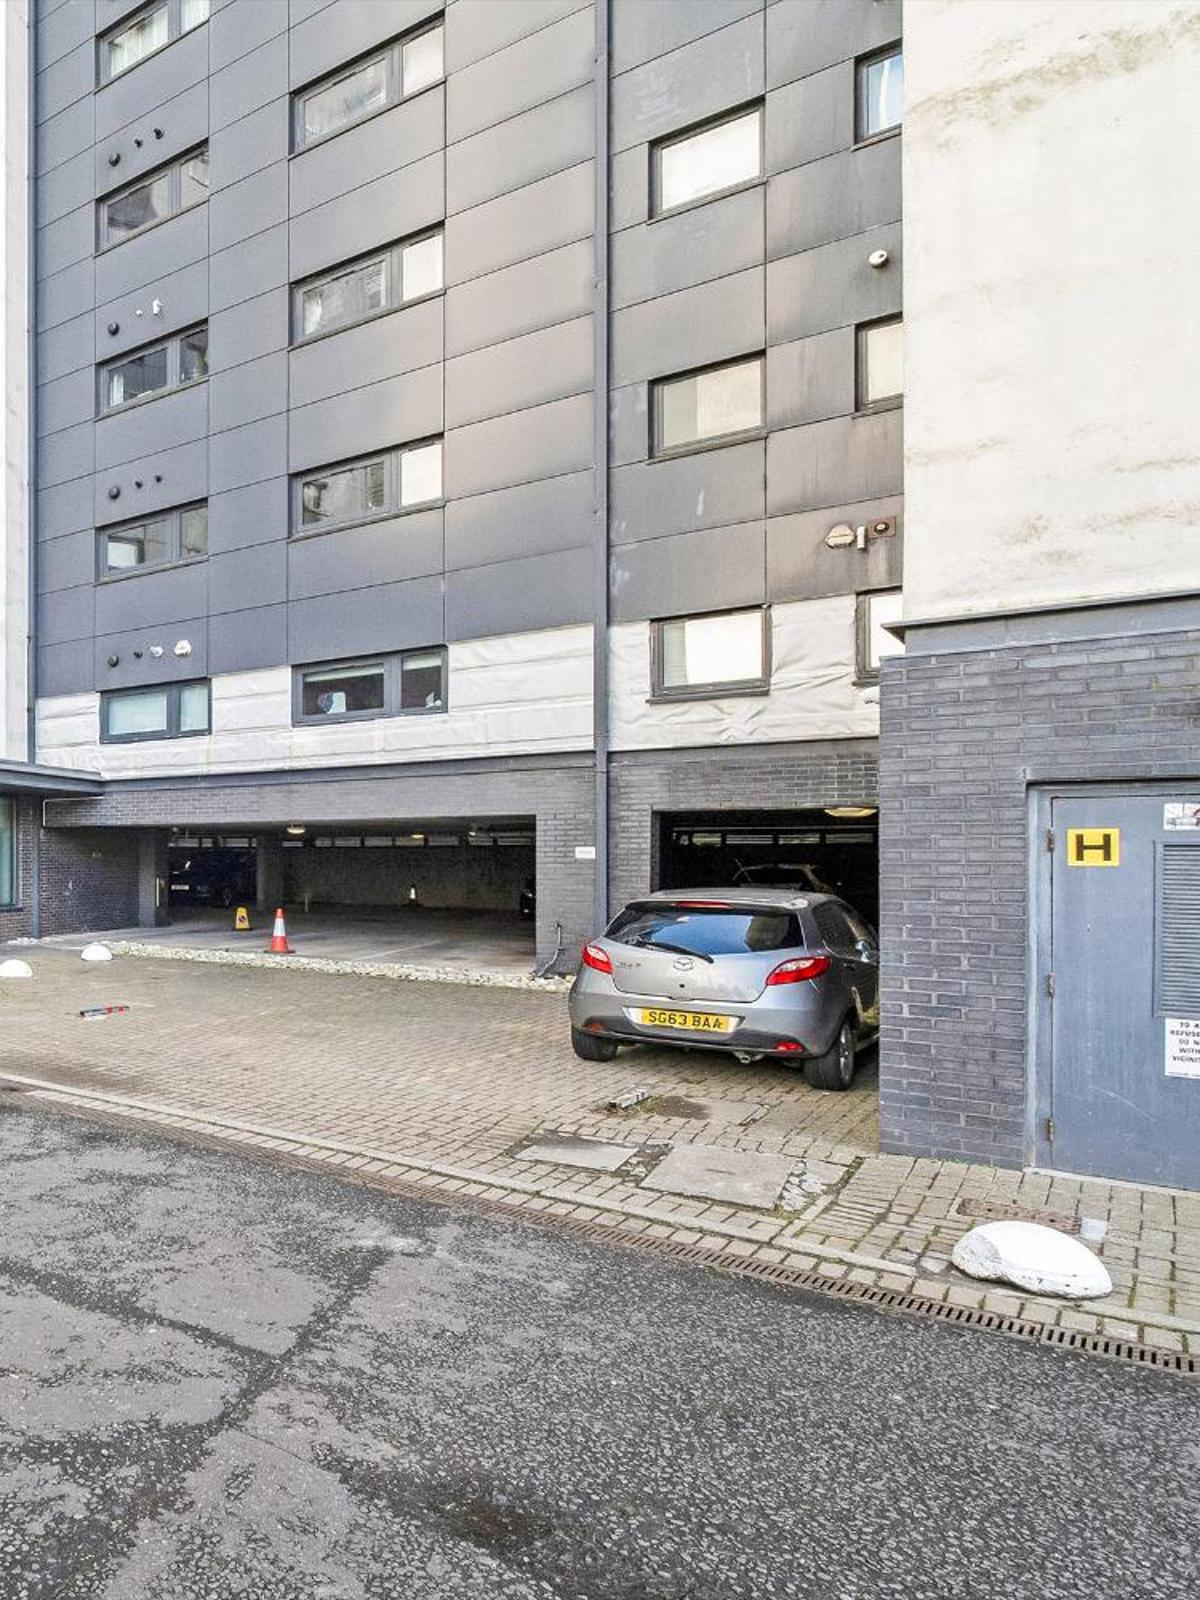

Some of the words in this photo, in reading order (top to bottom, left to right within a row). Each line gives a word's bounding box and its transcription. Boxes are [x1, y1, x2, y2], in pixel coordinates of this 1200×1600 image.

[1076, 833, 1111, 861] H
[648, 1010, 687, 1027] SG63
[692, 1014, 722, 1030] BAA
